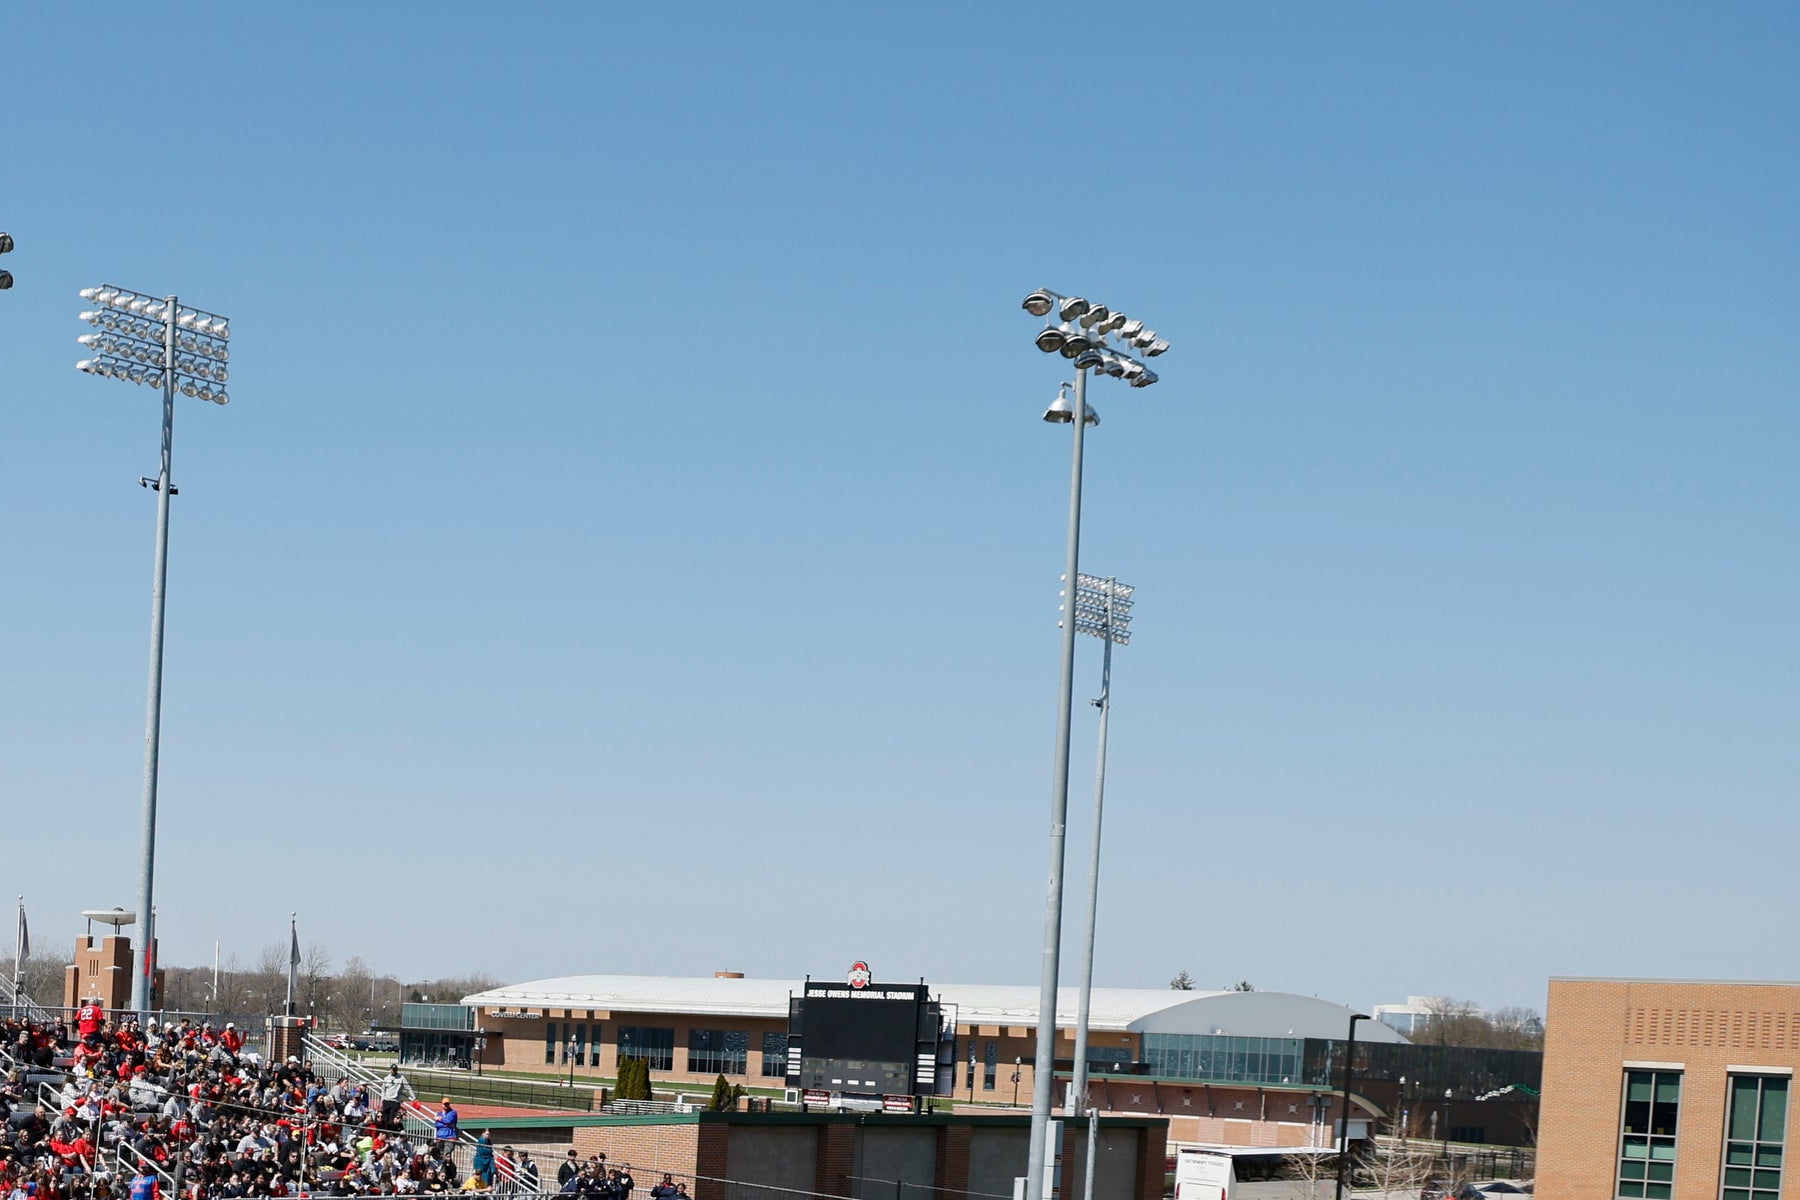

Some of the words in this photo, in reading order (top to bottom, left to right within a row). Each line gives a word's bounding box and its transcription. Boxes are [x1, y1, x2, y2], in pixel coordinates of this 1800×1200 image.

[807, 989, 827, 998] JESSE
[827, 990, 850, 999] OWENS
[850, 991, 885, 1000] MEMORIAL
[886, 991, 915, 1000] STADIUM
[81, 1008, 93, 1020] 22
[120, 1014, 136, 1022] 307
[516, 1012, 539, 1020] CENTER
